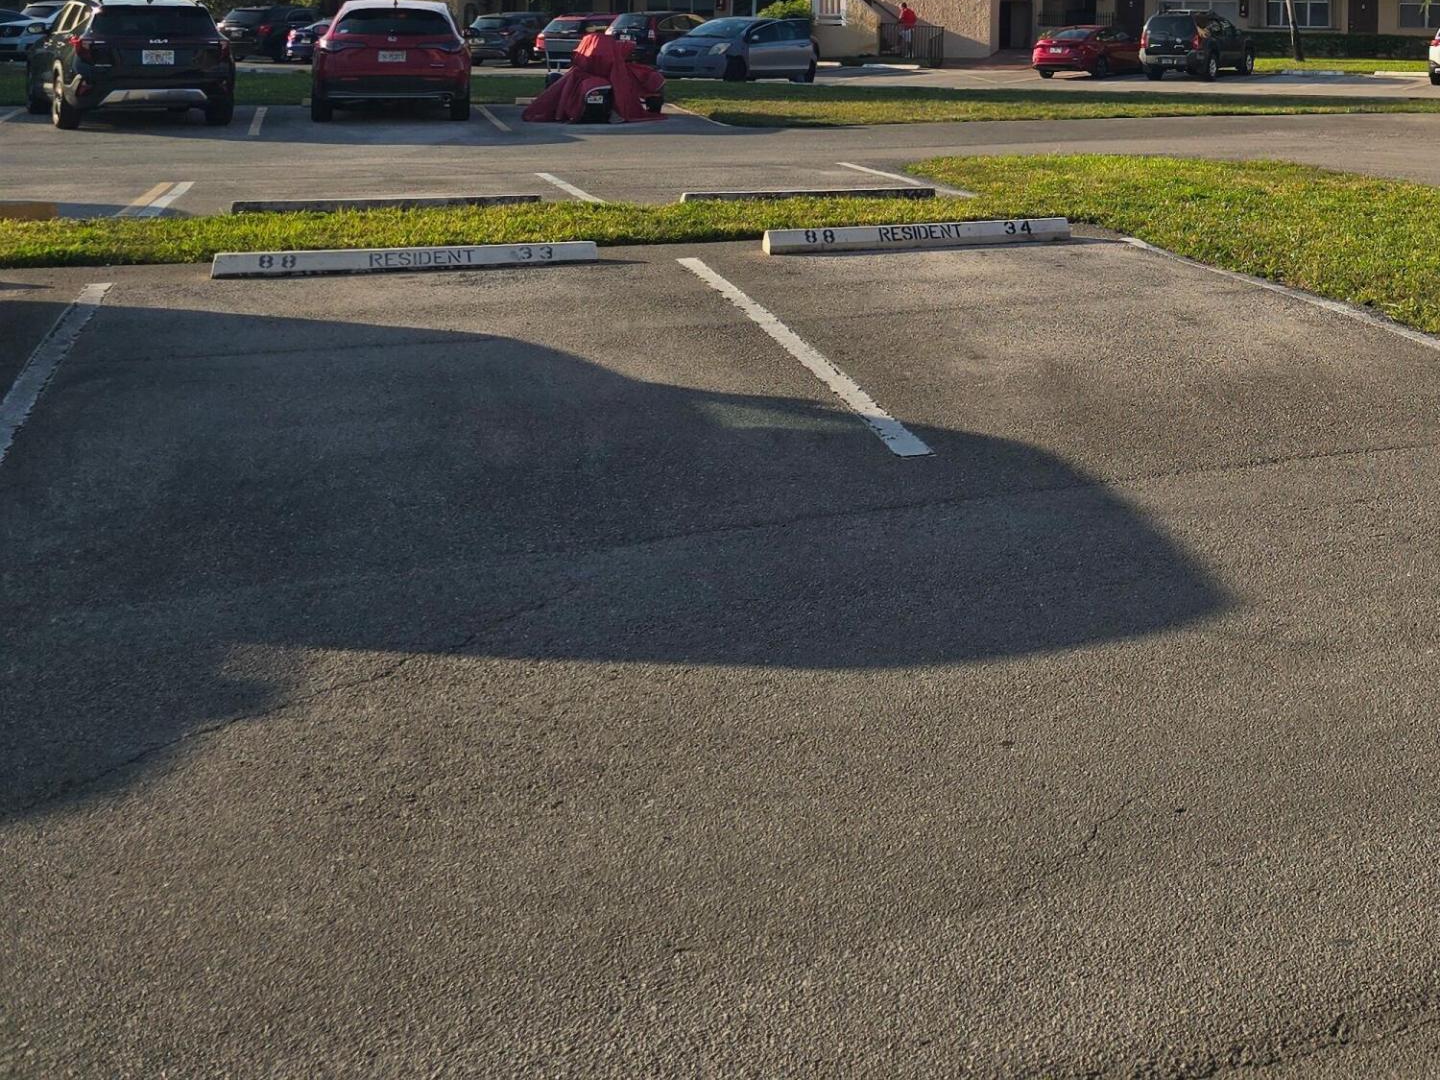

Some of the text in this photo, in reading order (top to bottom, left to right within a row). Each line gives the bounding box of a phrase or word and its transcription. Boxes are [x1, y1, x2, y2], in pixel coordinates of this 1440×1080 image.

[878, 223, 961, 242] RESIDENT
[1003, 221, 1032, 235] 34
[368, 248, 475, 267] RESIDENT
[519, 246, 553, 260] 33
